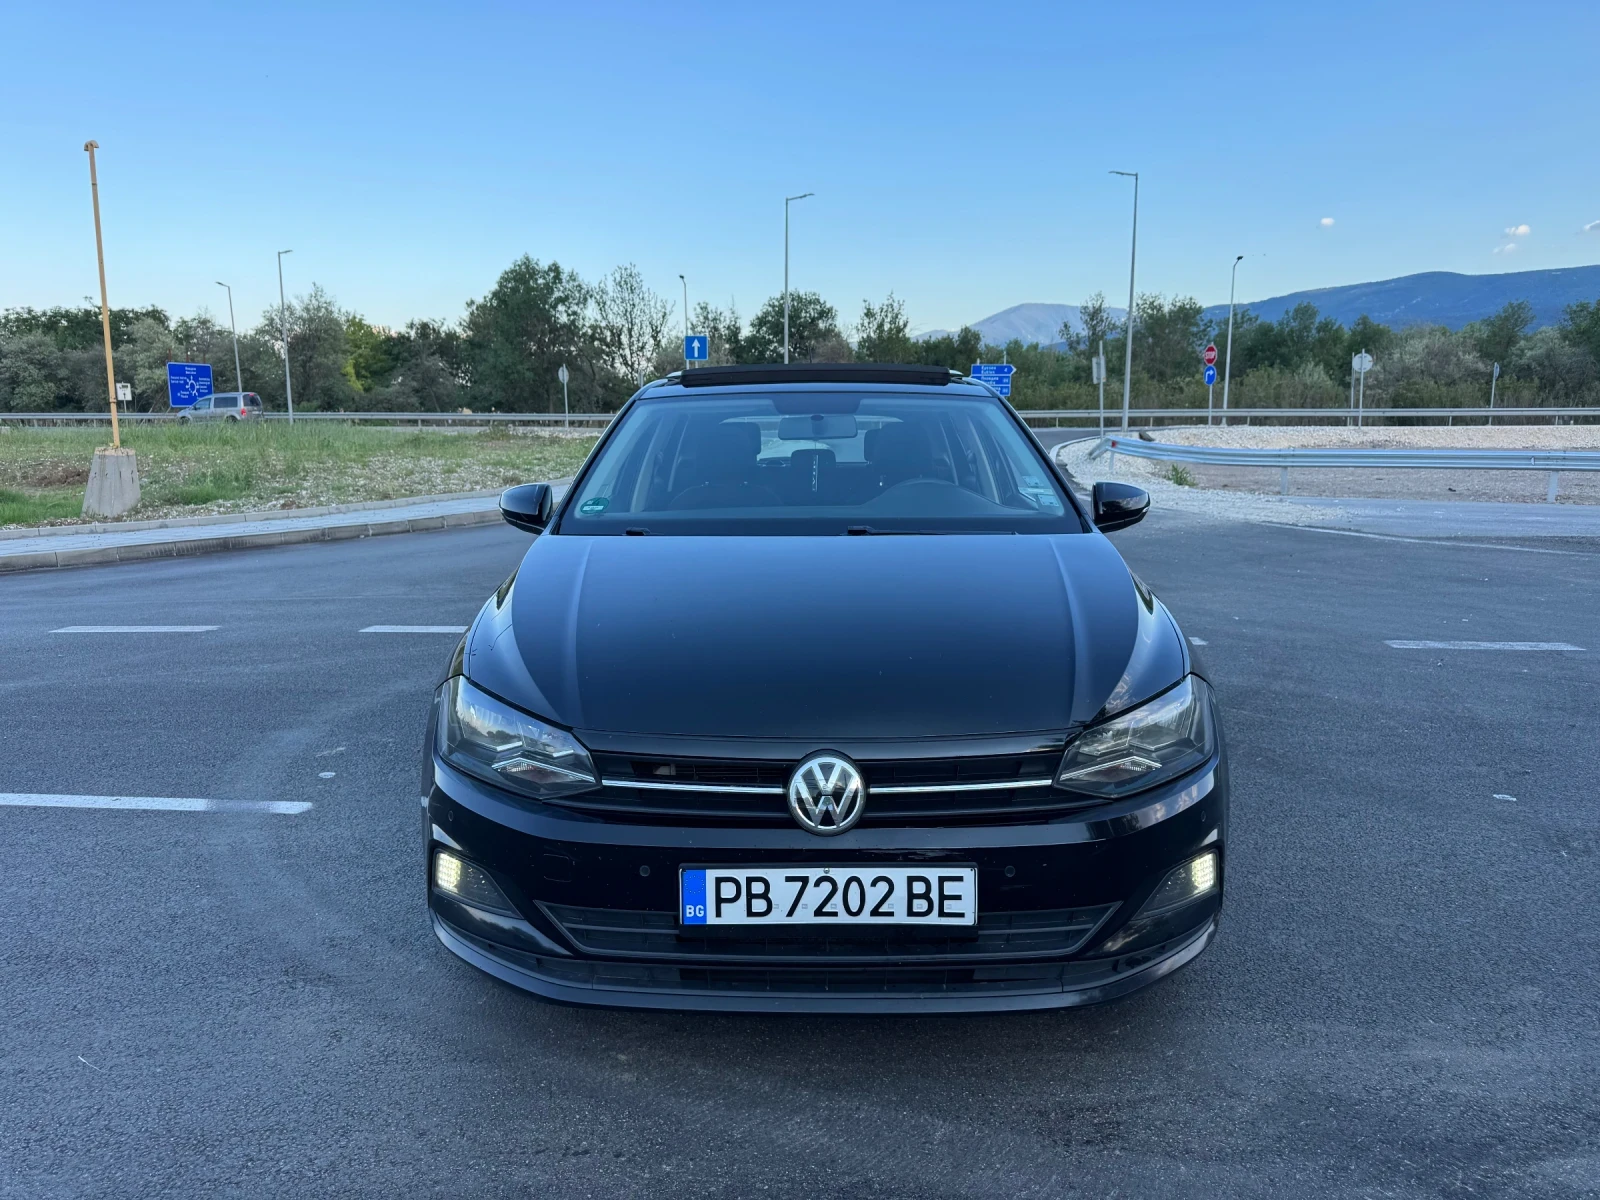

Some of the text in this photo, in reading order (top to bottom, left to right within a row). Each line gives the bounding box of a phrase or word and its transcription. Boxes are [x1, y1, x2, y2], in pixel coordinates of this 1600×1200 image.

[714, 875, 966, 918] PB 7202 BE
[685, 905, 705, 918] BG
